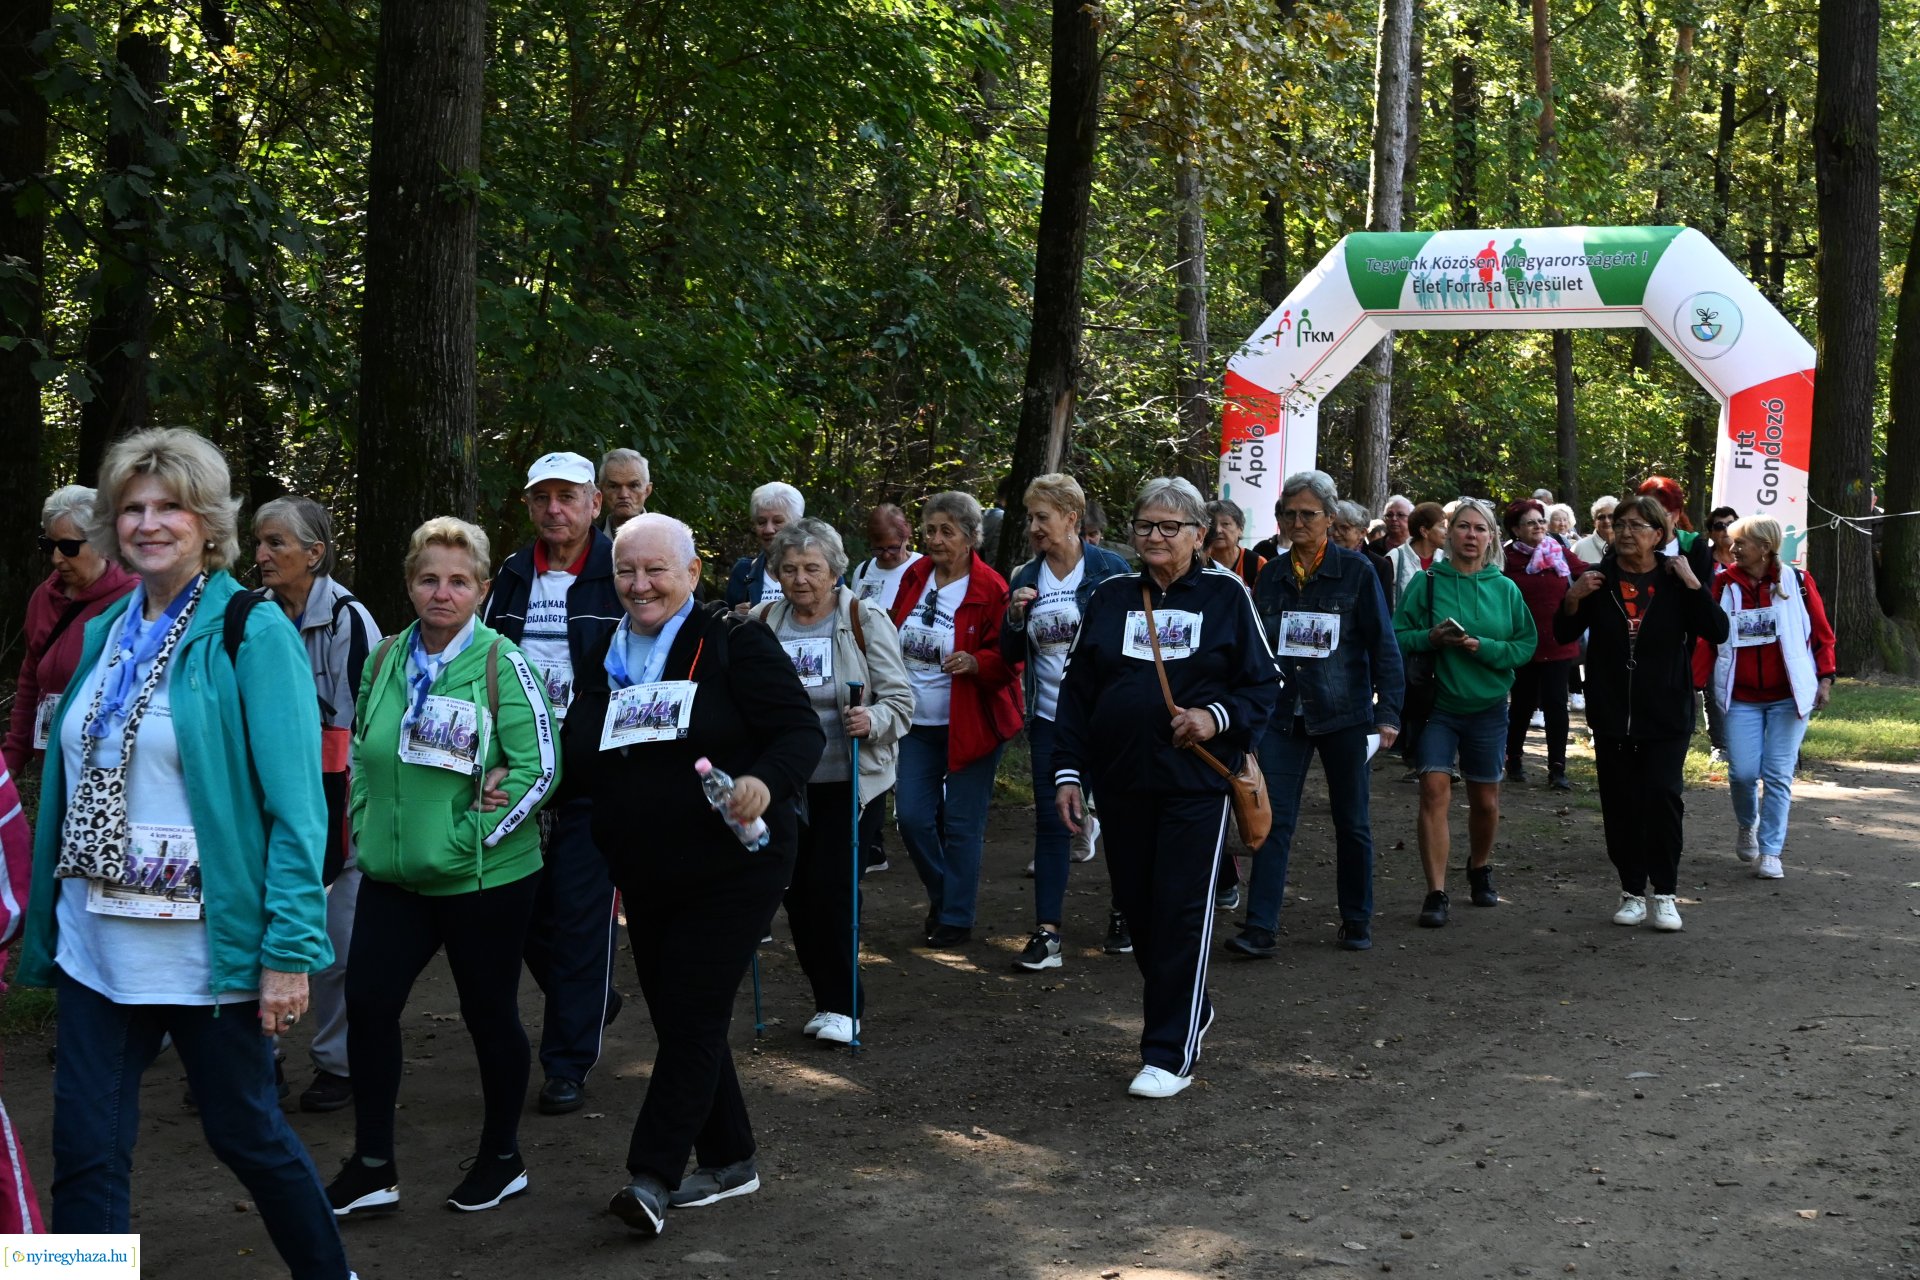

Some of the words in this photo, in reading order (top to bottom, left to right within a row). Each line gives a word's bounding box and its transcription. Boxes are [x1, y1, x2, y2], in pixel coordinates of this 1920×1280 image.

[1366, 256, 1428, 275] Tegyünk
[1432, 255, 1496, 271] Közösen
[1501, 251, 1636, 271] Magyarországért
[1413, 276, 1441, 294] Élet
[1447, 276, 1502, 293] Forrása
[1508, 276, 1583, 295] Egyesület
[1302, 331, 1334, 342] TKM
[1228, 439, 1243, 471] Fitt
[1241, 424, 1267, 489] Ápoló
[1735, 431, 1755, 469] Fitt
[1757, 399, 1784, 506] Gondozó
[538, 712, 551, 745] VOPSE
[622, 700, 672, 728] 274
[418, 719, 471, 749] 416
[123, 855, 189, 889] 377
